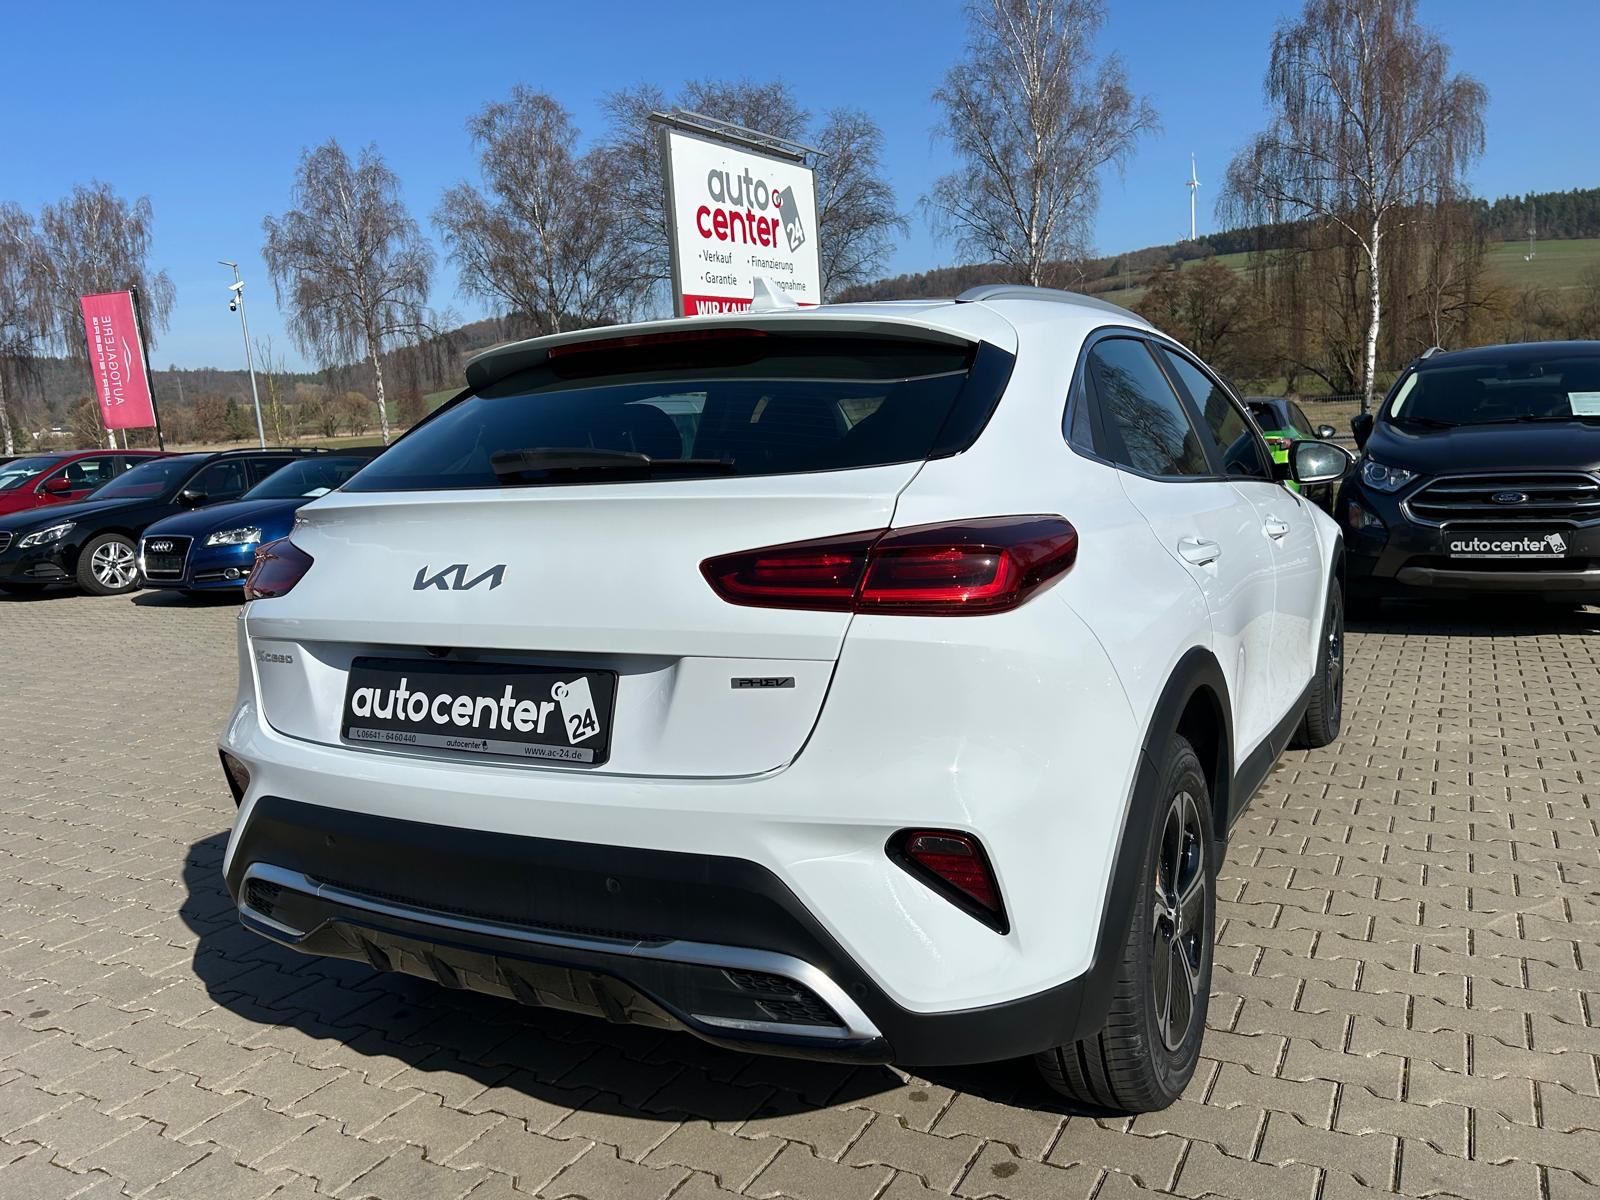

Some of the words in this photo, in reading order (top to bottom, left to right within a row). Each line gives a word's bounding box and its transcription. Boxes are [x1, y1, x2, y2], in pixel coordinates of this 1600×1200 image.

[707, 167, 769, 211] auto
[696, 205, 779, 248] center
[786, 217, 804, 247] 24
[703, 249, 732, 264] Verkauf
[751, 255, 794, 274] Finanzierung
[705, 271, 737, 286] Garantie
[1450, 537, 1547, 552] autocenter
[412, 563, 507, 591] KIA
[351, 677, 555, 734] autocenter
[568, 708, 596, 740] 24
[446, 739, 481, 749] autocenter
[524, 746, 583, 759] www.ac-24.de
